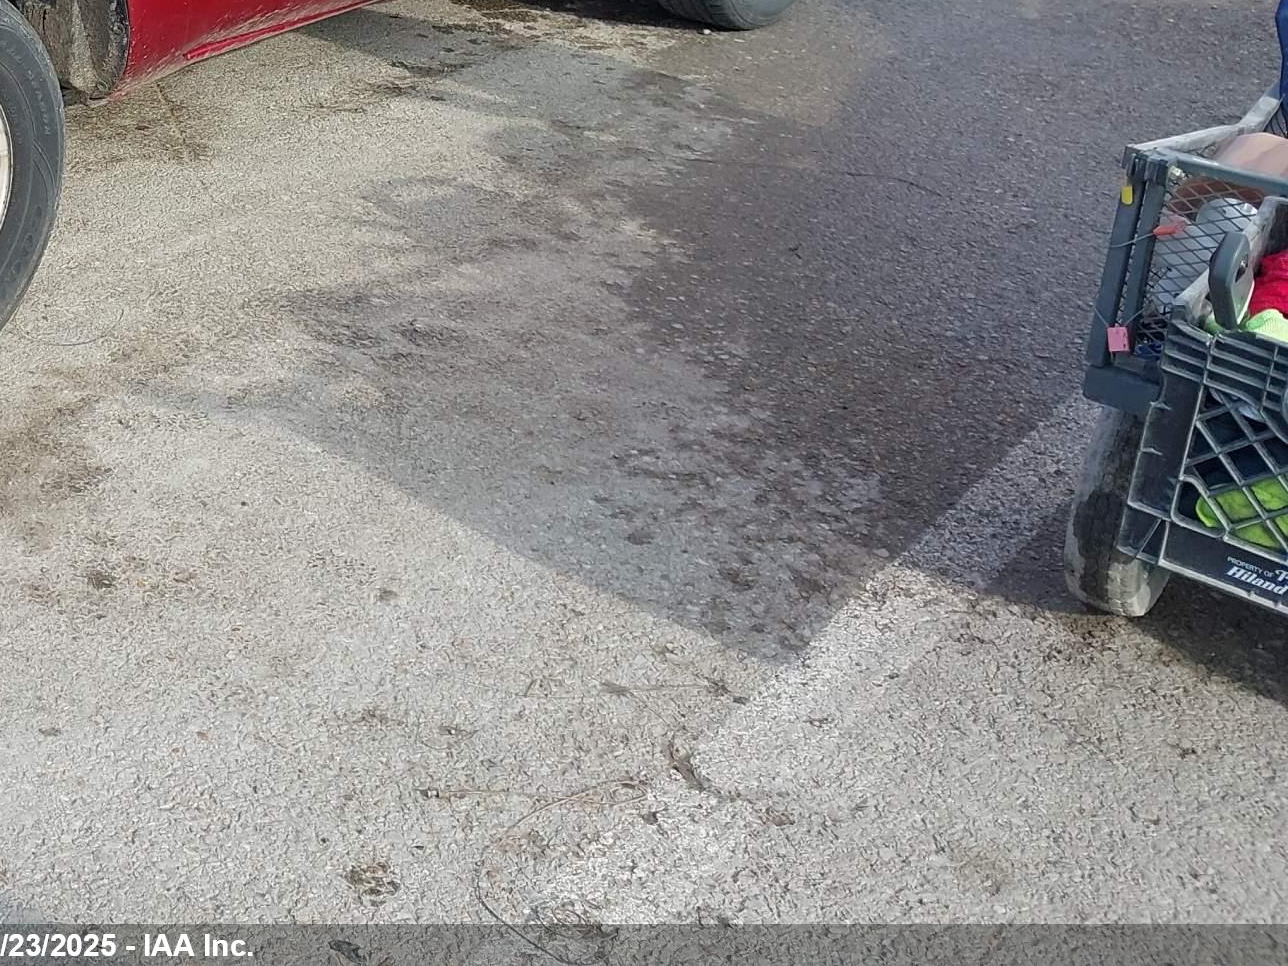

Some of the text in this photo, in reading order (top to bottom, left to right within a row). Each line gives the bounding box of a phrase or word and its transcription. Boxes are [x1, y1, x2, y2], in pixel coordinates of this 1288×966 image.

[1227, 556, 1263, 574] PROPERTY
[1264, 570, 1274, 578] OF
[1226, 566, 1288, 595] Hiland
